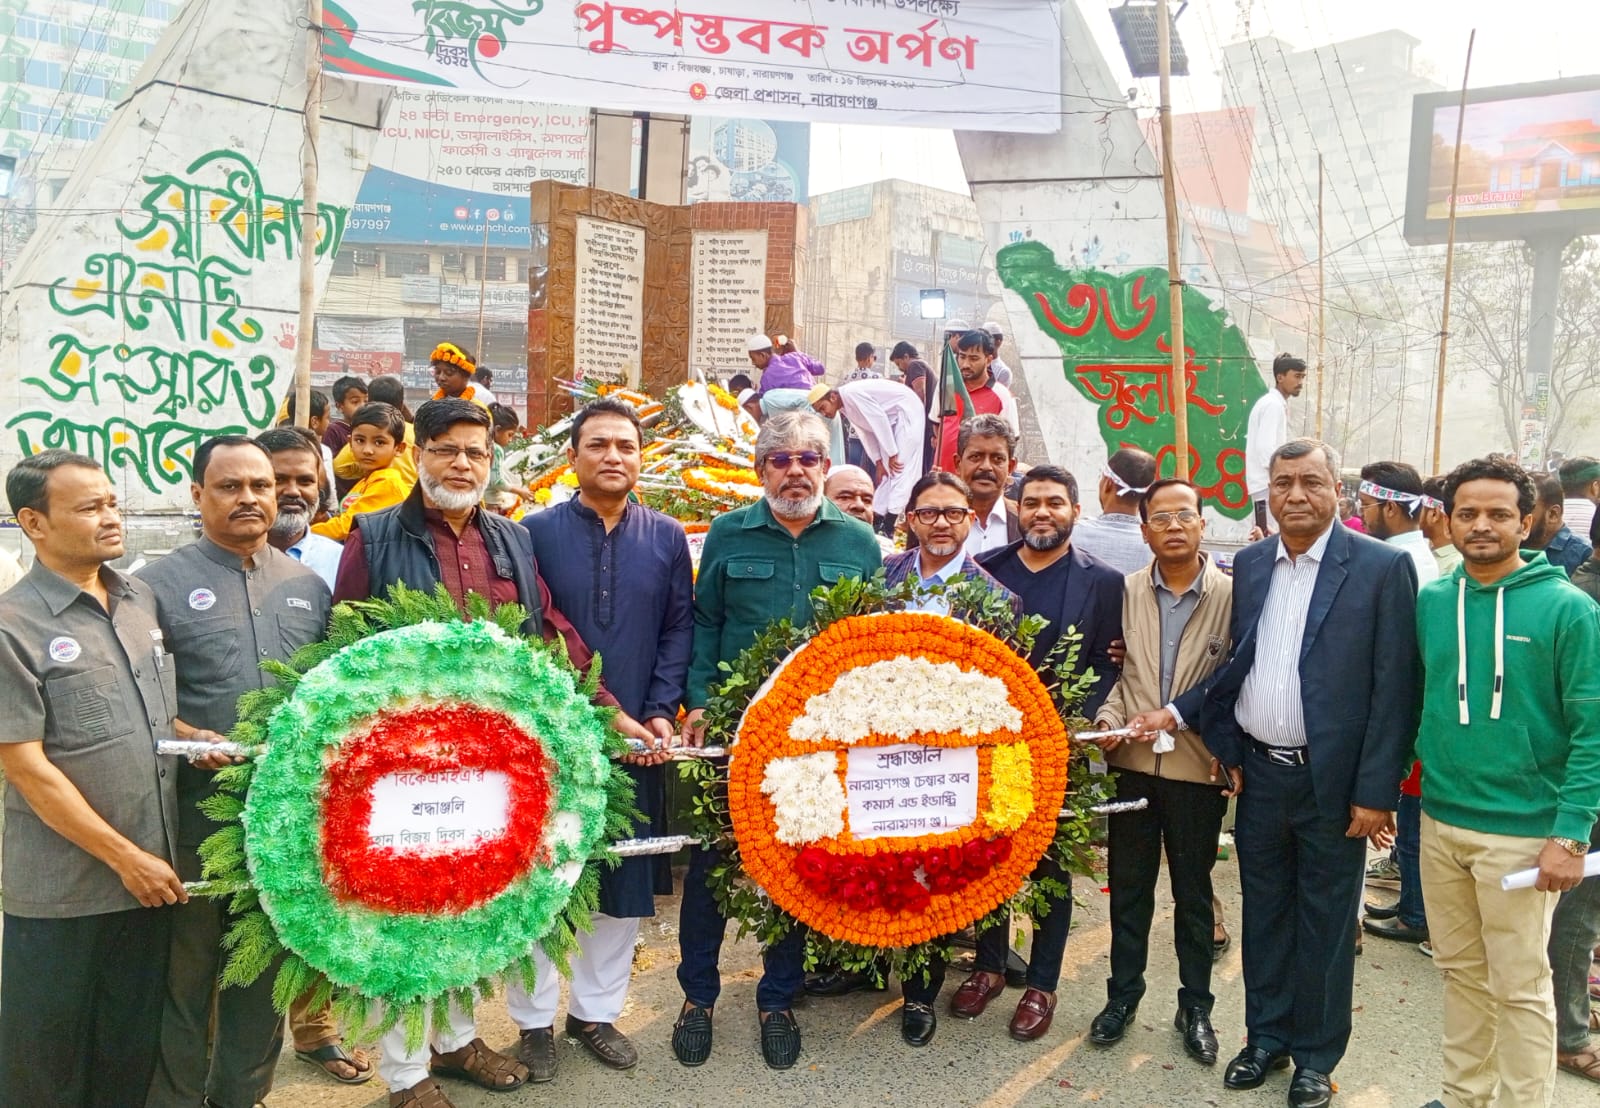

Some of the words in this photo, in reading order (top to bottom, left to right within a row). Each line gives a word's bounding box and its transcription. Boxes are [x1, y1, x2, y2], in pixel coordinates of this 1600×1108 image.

[575, 2, 829, 59] পুষ্পস্তবক
[843, 19, 979, 70] অর্পণ
[715, 86, 749, 101] জেলা
[809, 93, 878, 110] নারায়ণগঞ্জ
[399, 111, 418, 121] ২৪
[453, 112, 544, 128] Emergency,
[546, 117, 575, 128] ICU,
[414, 128, 454, 143] NICU,
[436, 165, 463, 177] ২৫০
[465, 166, 501, 178] বেডের
[504, 165, 537, 179] একটি
[115, 149, 347, 263] স্বাধীনতা
[49, 252, 263, 342] এনেছি
[1073, 332, 1227, 431] জুলাই
[877, 745, 943, 769] শ্রদ্ধাঞ্জলি
[848, 776, 911, 792] নারায়ণগঞ্জ
[913, 774, 946, 789] চেম্বার
[948, 772, 970, 785] অব
[411, 796, 466, 816] শ্রদ্ধাঞ্জলি
[862, 797, 894, 812] কমার্স
[371, 833, 394, 847] হান
[400, 828, 431, 846] বিজয়
[436, 826, 465, 842] দিবস
